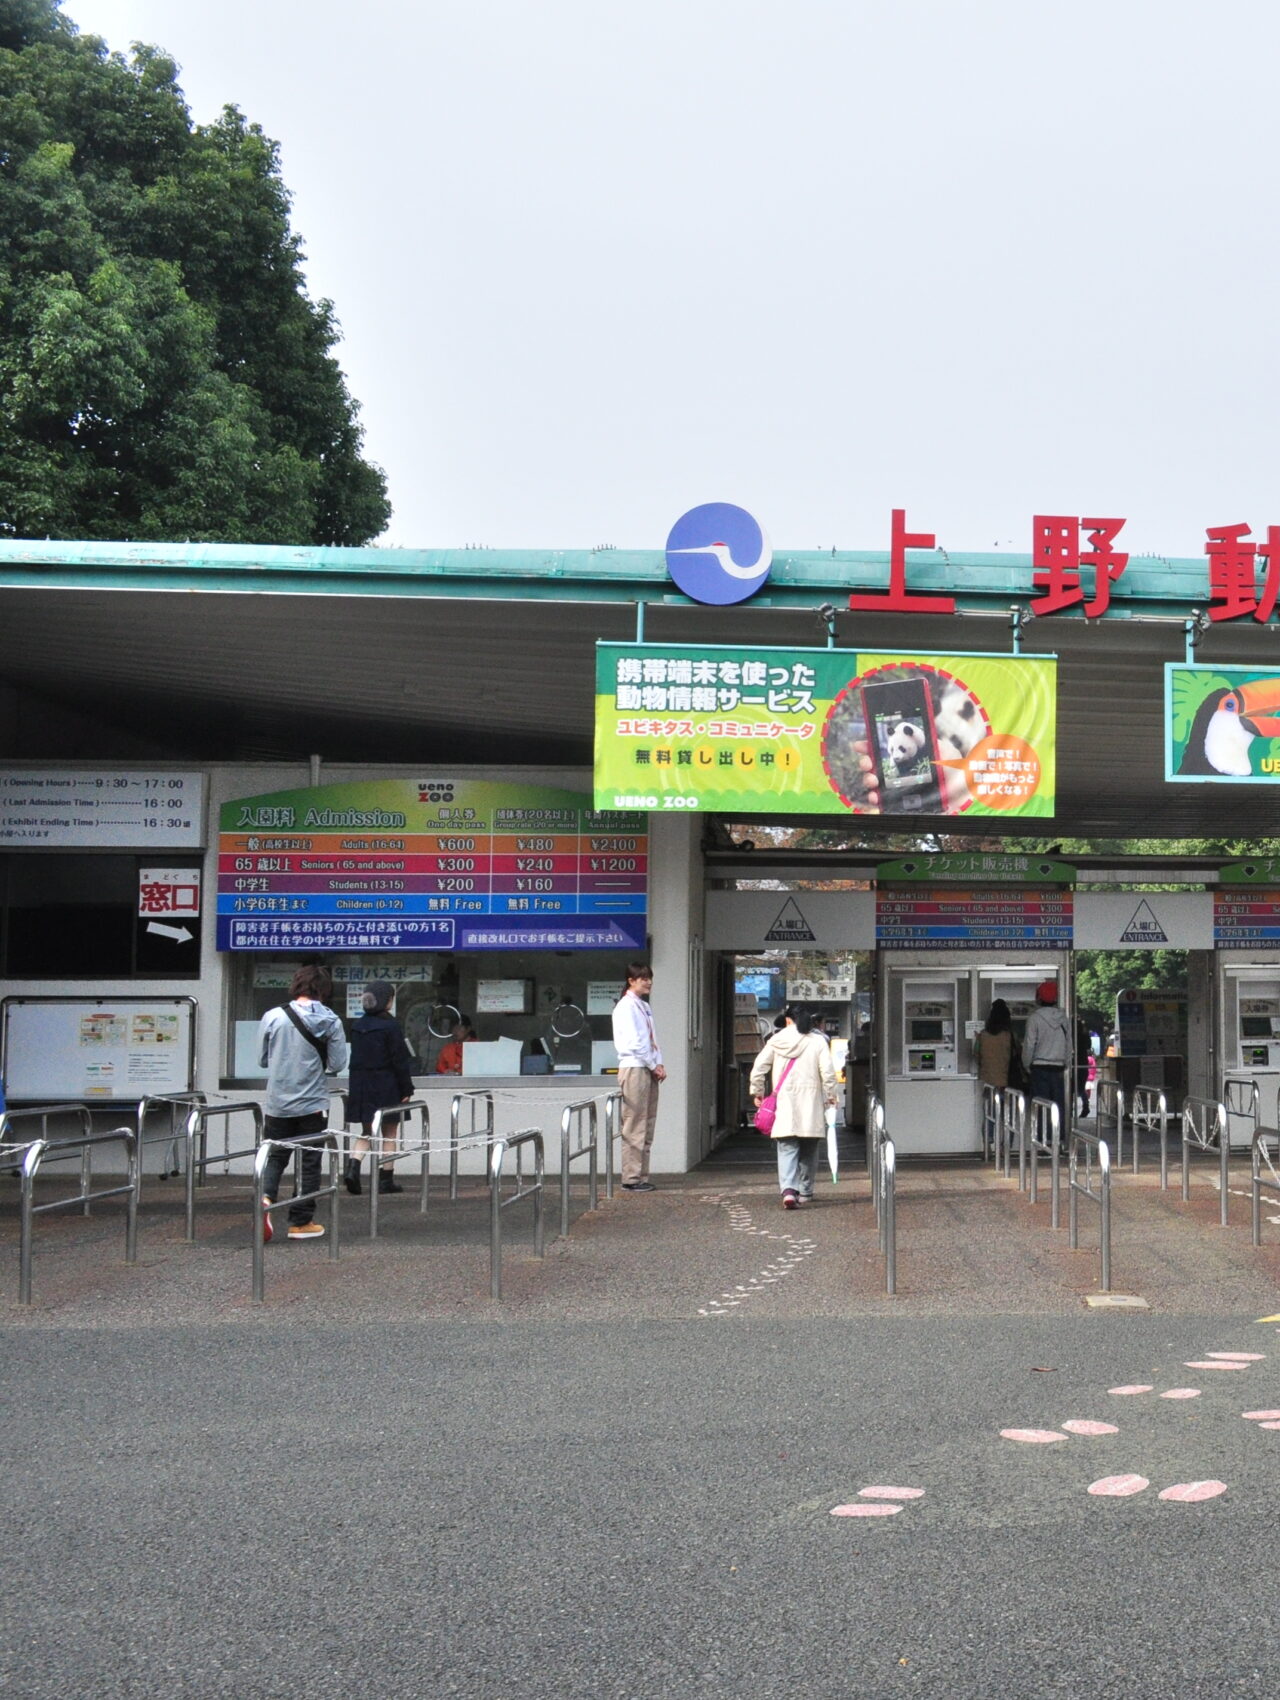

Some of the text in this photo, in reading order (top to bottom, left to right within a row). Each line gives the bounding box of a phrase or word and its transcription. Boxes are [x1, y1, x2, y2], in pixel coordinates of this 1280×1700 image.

[617, 658, 816, 687] 携帯端末を使った
[615, 685, 815, 713] 動物情報サービス
[617, 720, 815, 738] ユビキタス・コミュニケータ
[418, 783, 454, 791] ueno
[33, 798, 71, 806] Admission
[614, 796, 698, 808] UENO ZOO
[236, 807, 295, 827] 入園料
[304, 808, 405, 827] Admission
[41, 819, 69, 828] Ending
[427, 821, 444, 829] One
[341, 840, 368, 849] Adults
[438, 839, 475, 850] ¥600
[517, 839, 553, 850] ¥480
[591, 839, 636, 850] ¥2400
[235, 858, 252, 870] 65
[301, 860, 404, 870] Seniors and above)
[438, 859, 474, 871] ¥300
[517, 859, 553, 871] ¥240
[591, 859, 636, 871] ¥1200
[925, 856, 1029, 872] チケット販売機
[235, 878, 270, 891] 中学生
[329, 880, 404, 890] Students (13-15)
[437, 879, 474, 891] ¥200
[516, 879, 552, 891] ¥160
[141, 881, 198, 912] 窓口
[336, 900, 404, 909] Children (0-12)
[428, 899, 482, 910] 無料 Free
[508, 899, 561, 910] 無料 Free
[939, 904, 965, 912] Seniors
[1040, 904, 1062, 912] ¥300
[235, 935, 401, 946] 都内在住在学の中学生は無料です
[468, 933, 623, 944] 直接改札口でお手帳をご提示下さい
[768, 932, 811, 940] ENTRANCE
[1123, 933, 1165, 941] ENTRANCE
[334, 966, 430, 981] 年間パスポート
